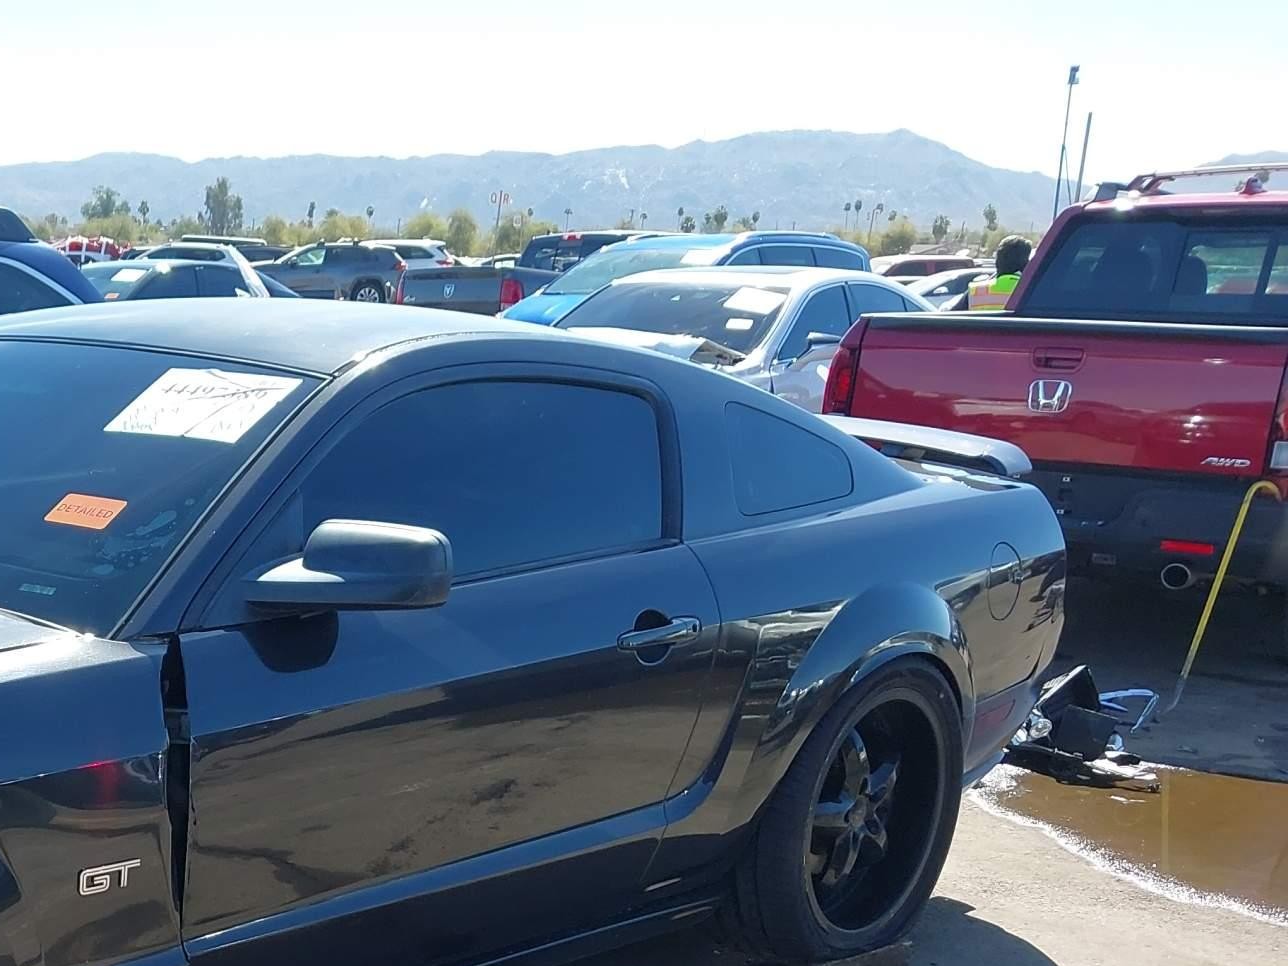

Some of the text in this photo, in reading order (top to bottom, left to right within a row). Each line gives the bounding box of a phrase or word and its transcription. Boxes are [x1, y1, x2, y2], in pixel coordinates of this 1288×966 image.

[1200, 457, 1252, 467] AWD
[57, 504, 114, 518] DETAILED
[79, 858, 141, 896] GT
